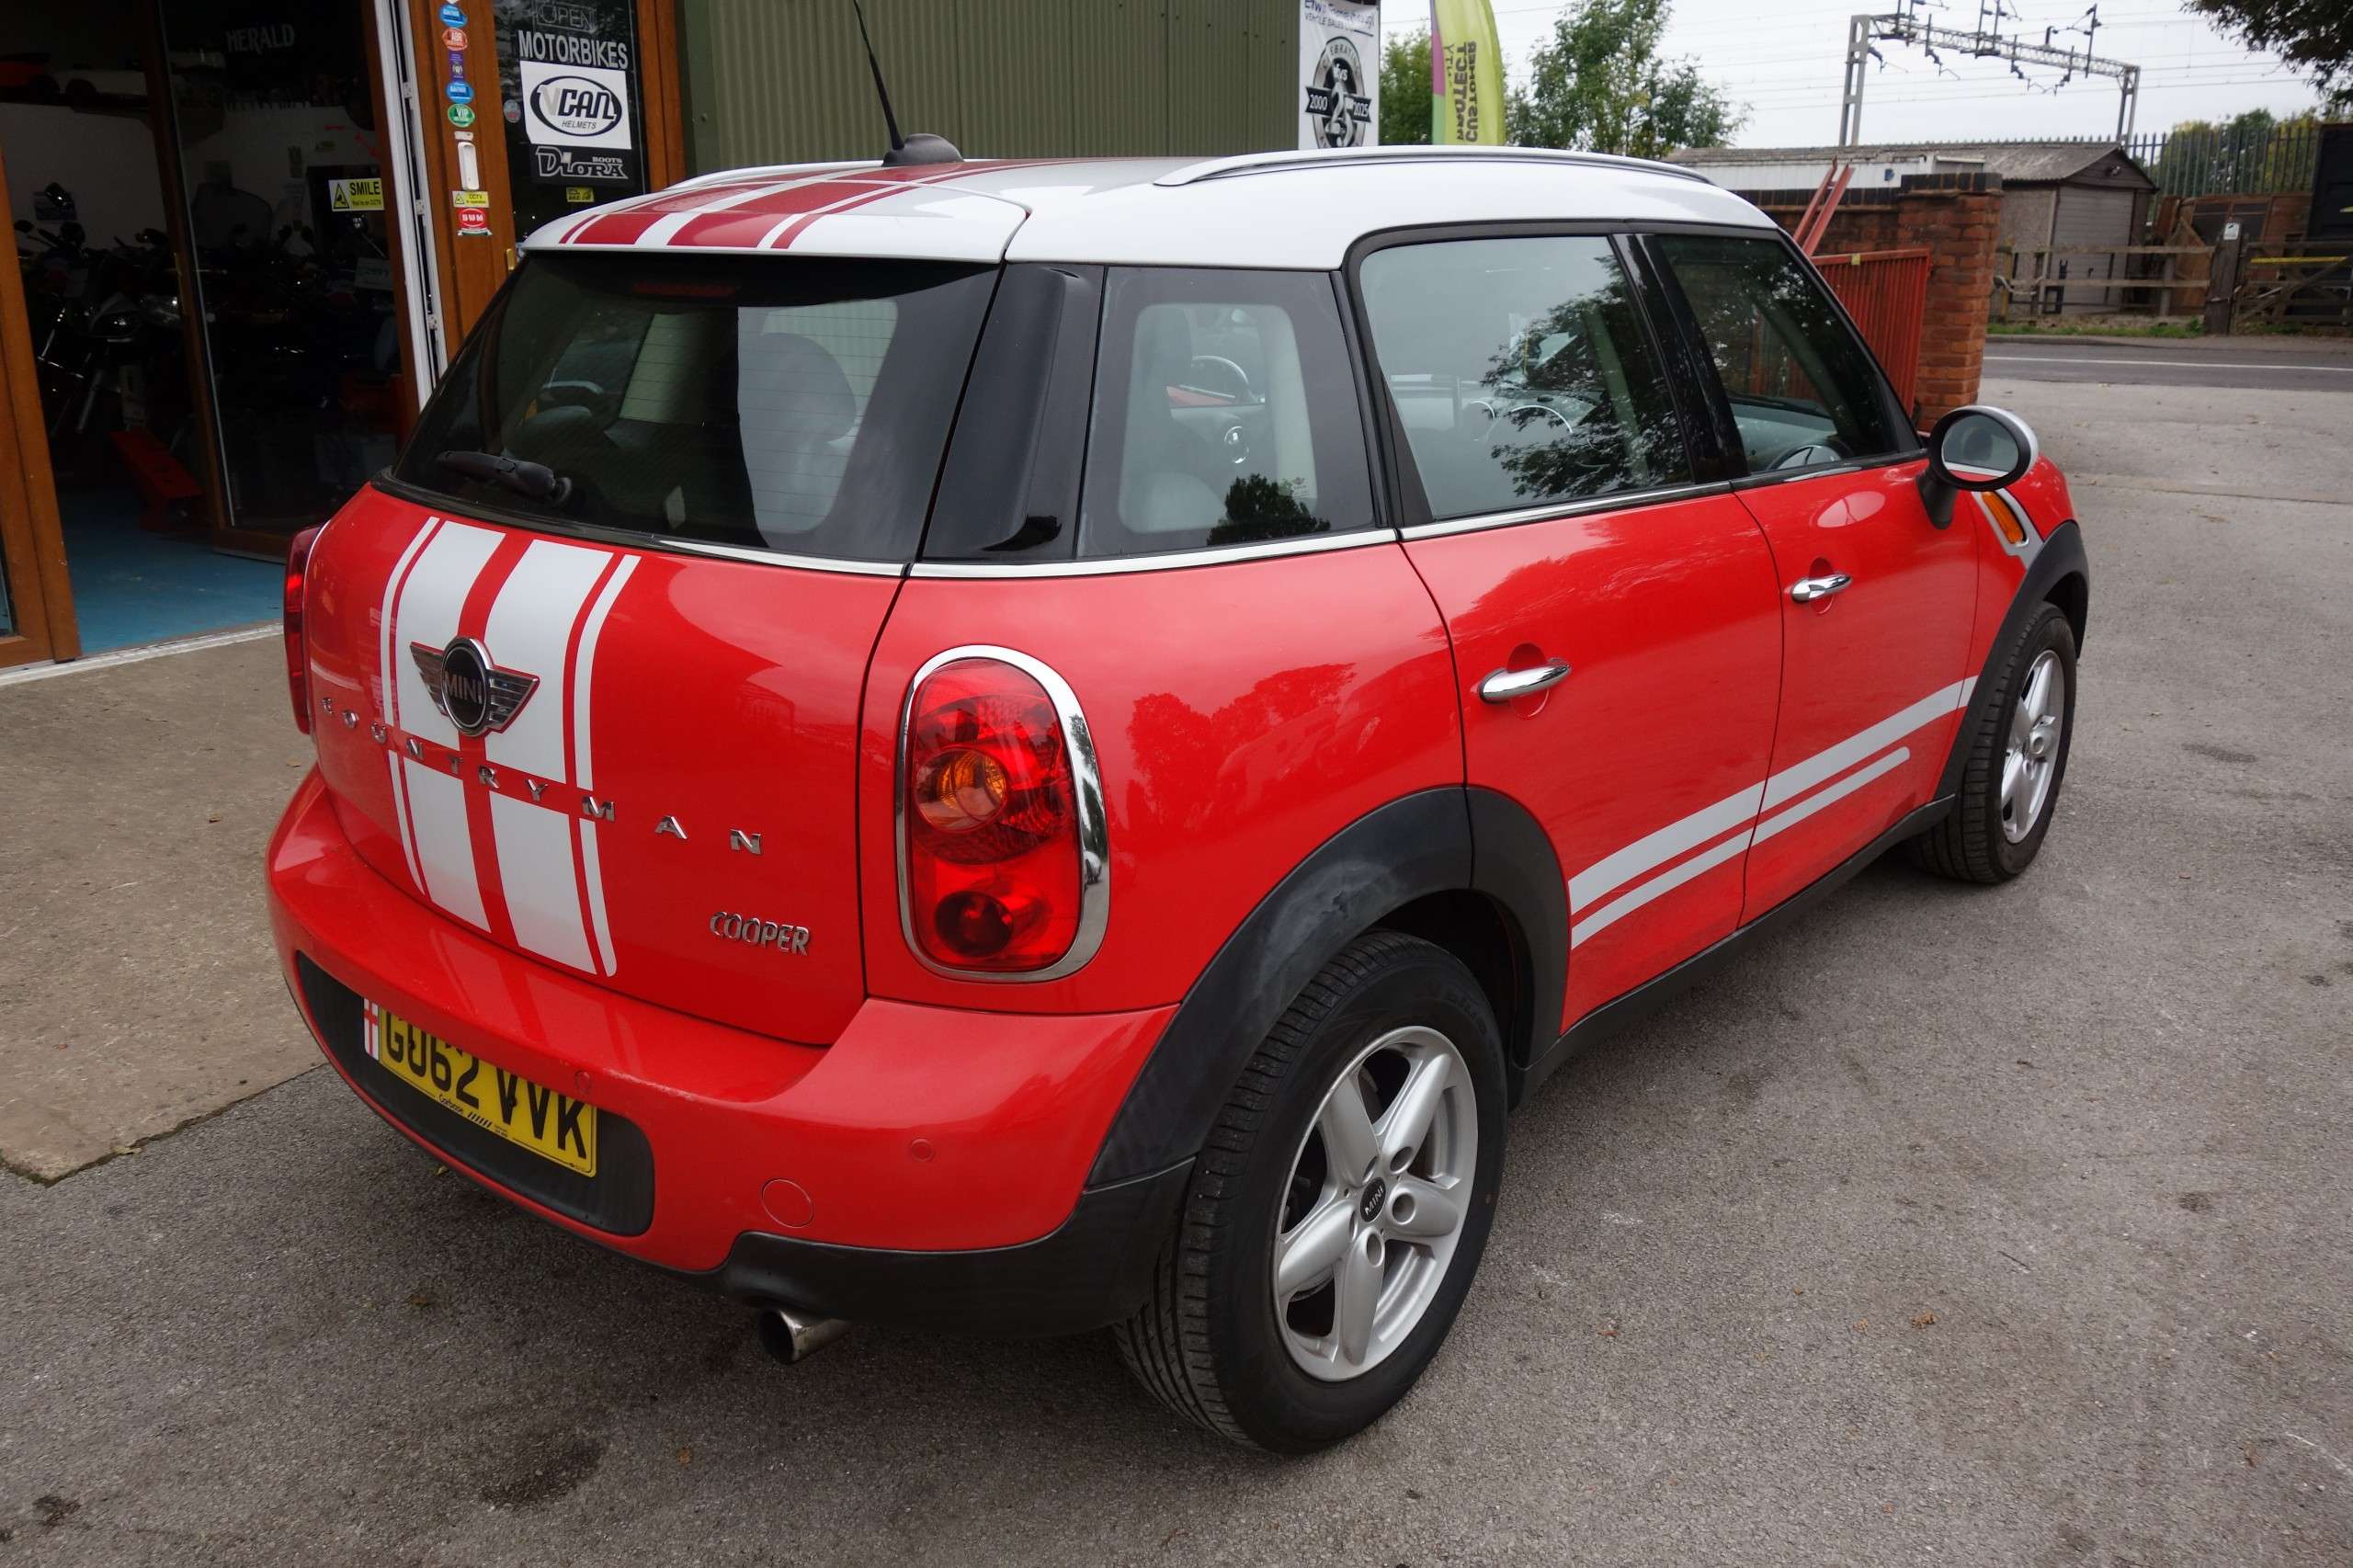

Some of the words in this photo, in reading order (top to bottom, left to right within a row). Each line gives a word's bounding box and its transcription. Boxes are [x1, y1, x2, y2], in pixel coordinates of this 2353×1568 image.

[225, 23, 294, 55] HERALD
[517, 29, 629, 70] MOTORBIKES
[1310, 94, 1328, 111] 2000
[1353, 101, 1369, 118] 2025
[562, 119, 597, 130] HELMETS
[592, 155, 623, 164] BOOTS
[350, 181, 381, 196] SMILE
[444, 670, 483, 705] MINI
[321, 696, 763, 856] COUNTRYMAN
[709, 911, 811, 957] COOPER
[386, 1011, 480, 1110] GU62
[496, 1066, 587, 1160] VVK
[1365, 1185, 1383, 1216] MINI
